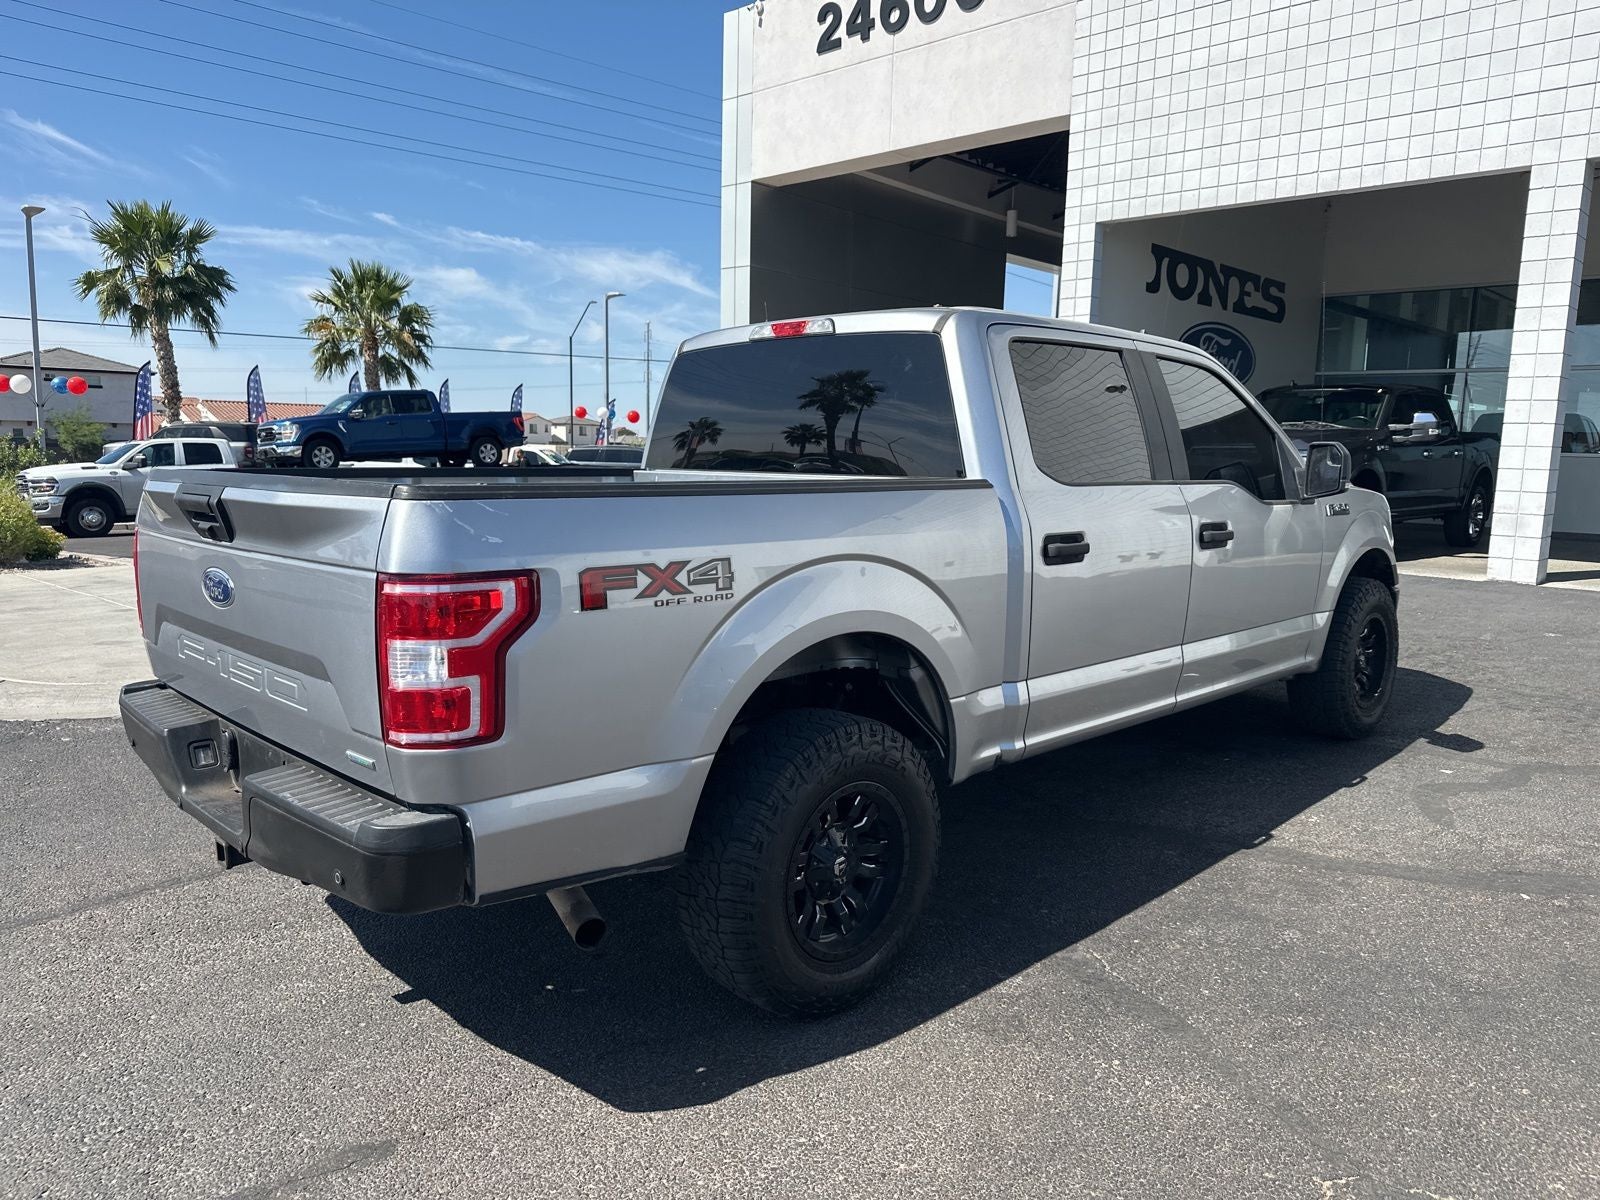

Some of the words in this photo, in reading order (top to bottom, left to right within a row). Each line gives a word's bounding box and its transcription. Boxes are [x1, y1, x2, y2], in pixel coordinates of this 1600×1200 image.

[816, 0, 984, 56] 2460
[1146, 242, 1286, 324] JONES
[1200, 332, 1242, 376] Frd
[578, 557, 735, 611] FX4
[654, 597, 687, 608] OFF
[693, 592, 734, 604] ROAD
[177, 633, 308, 712] F-150
